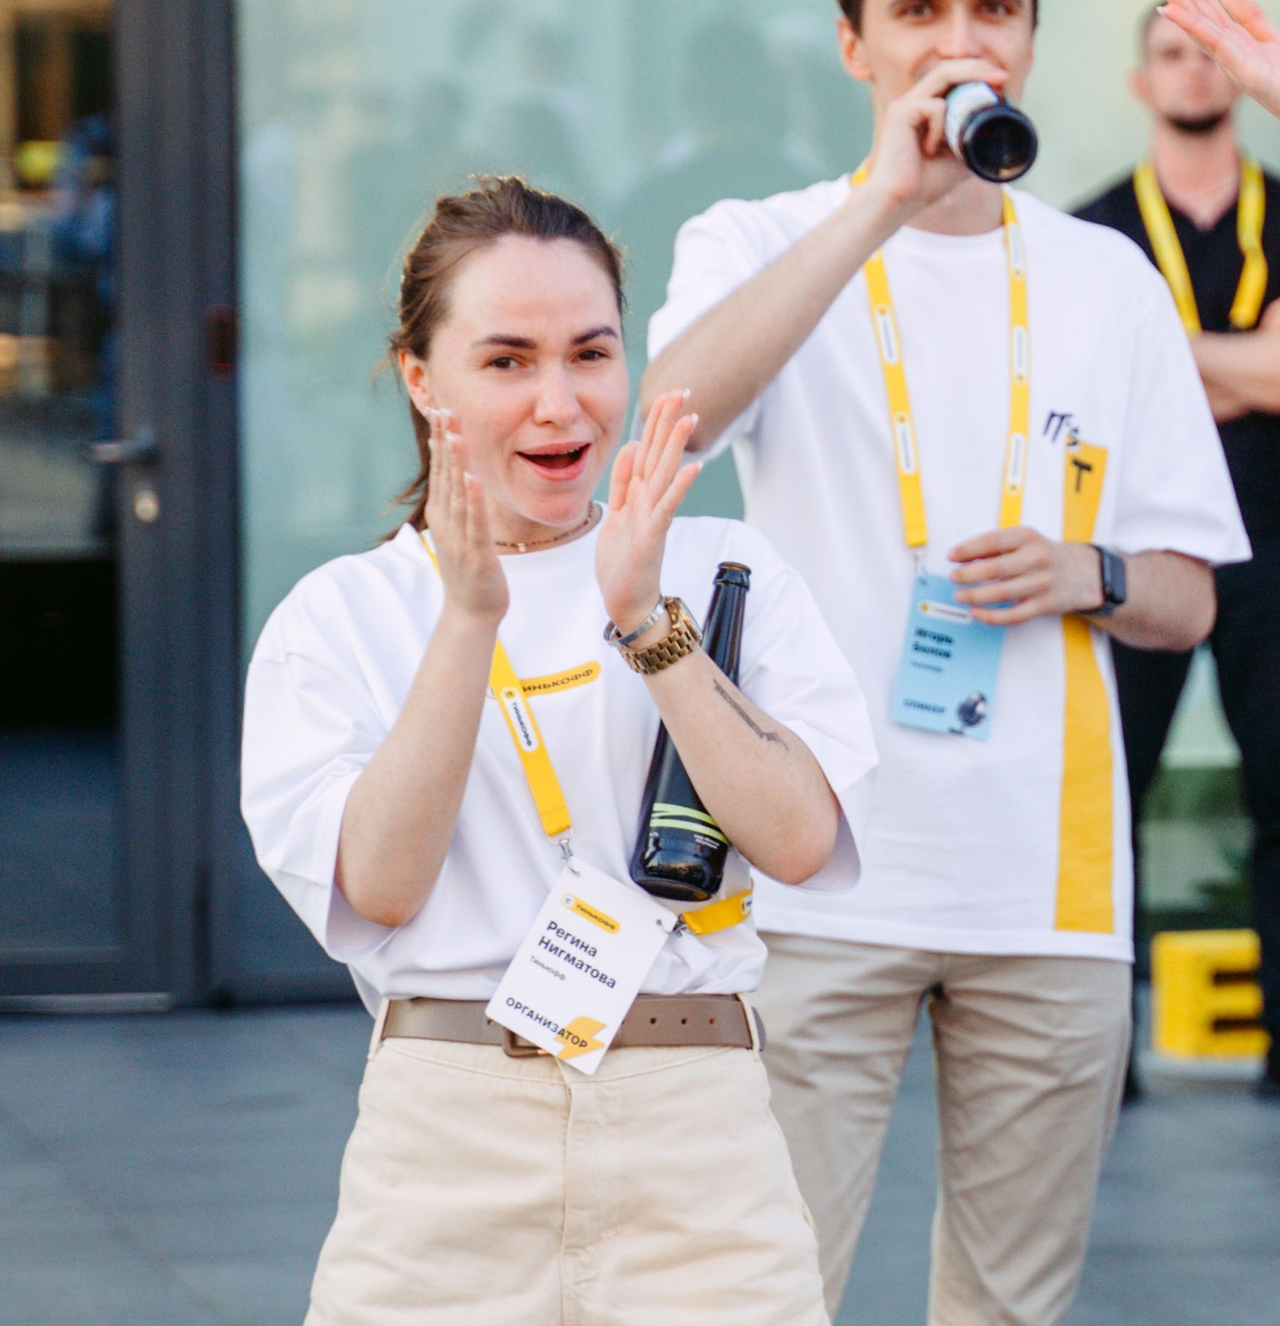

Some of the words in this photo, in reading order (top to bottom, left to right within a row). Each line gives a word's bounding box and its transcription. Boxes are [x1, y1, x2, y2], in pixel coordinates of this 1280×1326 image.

[521, 668, 594, 693] ИНЬКОФФ
[546, 920, 599, 958] Регина
[537, 935, 617, 990] Нигматова
[505, 996, 589, 1049] ОРГАНИЗАТОР
